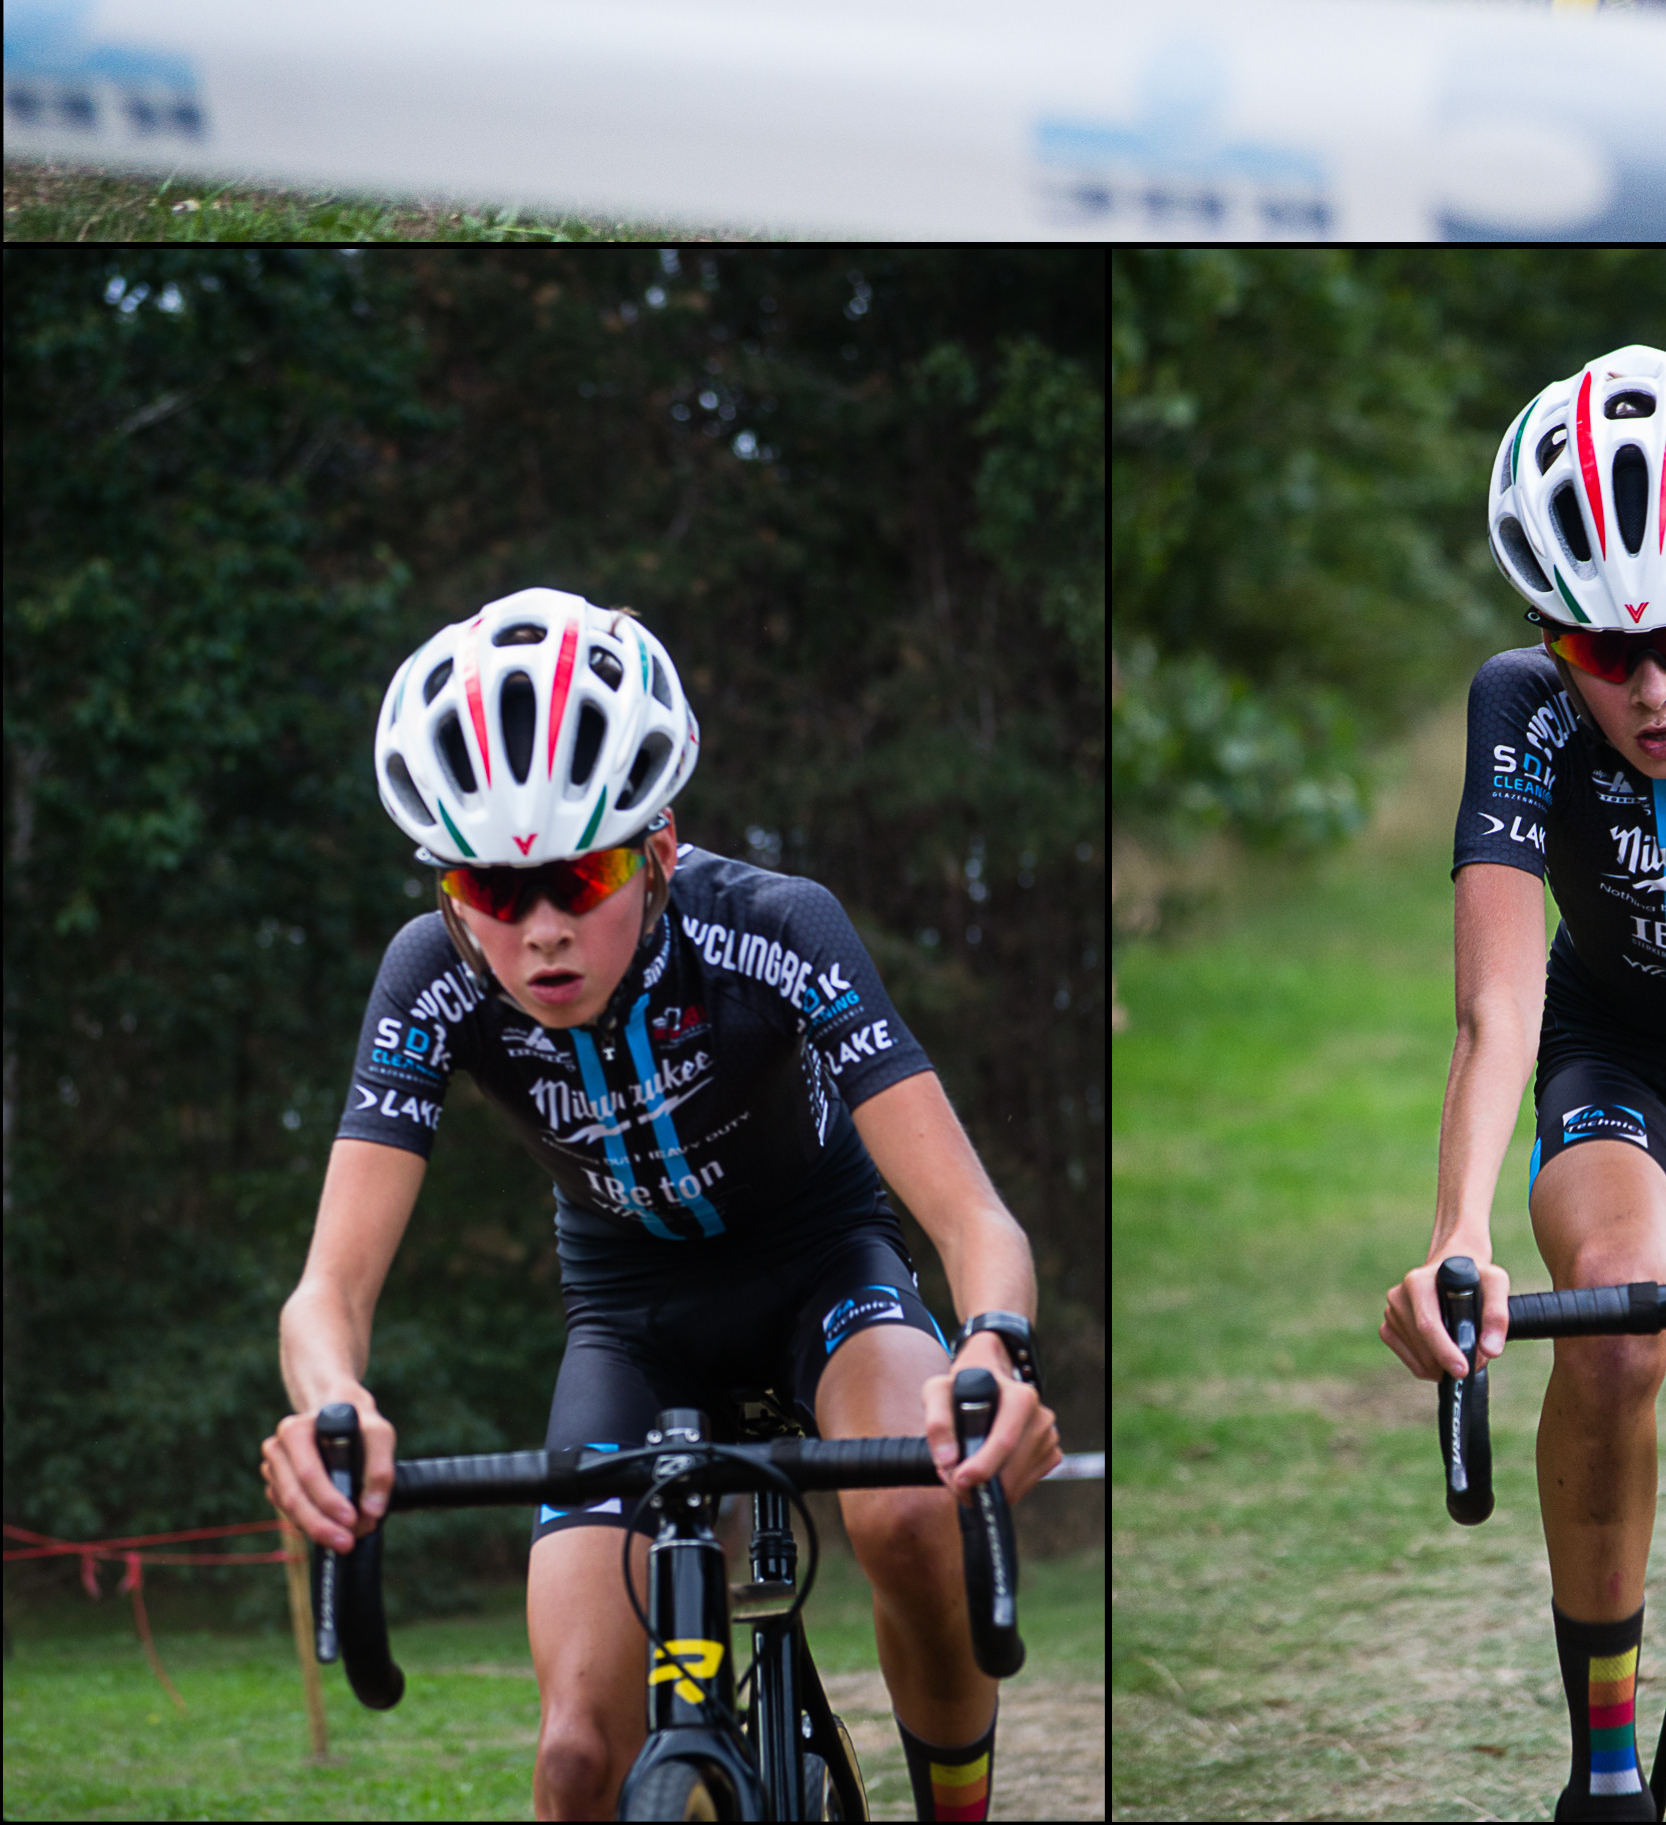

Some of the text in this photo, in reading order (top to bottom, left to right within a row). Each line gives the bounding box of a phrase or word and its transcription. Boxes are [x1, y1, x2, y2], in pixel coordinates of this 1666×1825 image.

[1510, 815, 1547, 854] LAK
[1599, 881, 1657, 912] Nothing
[825, 1018, 894, 1075] LAKE
[1452, 1378, 1464, 1465] LTEGRA
